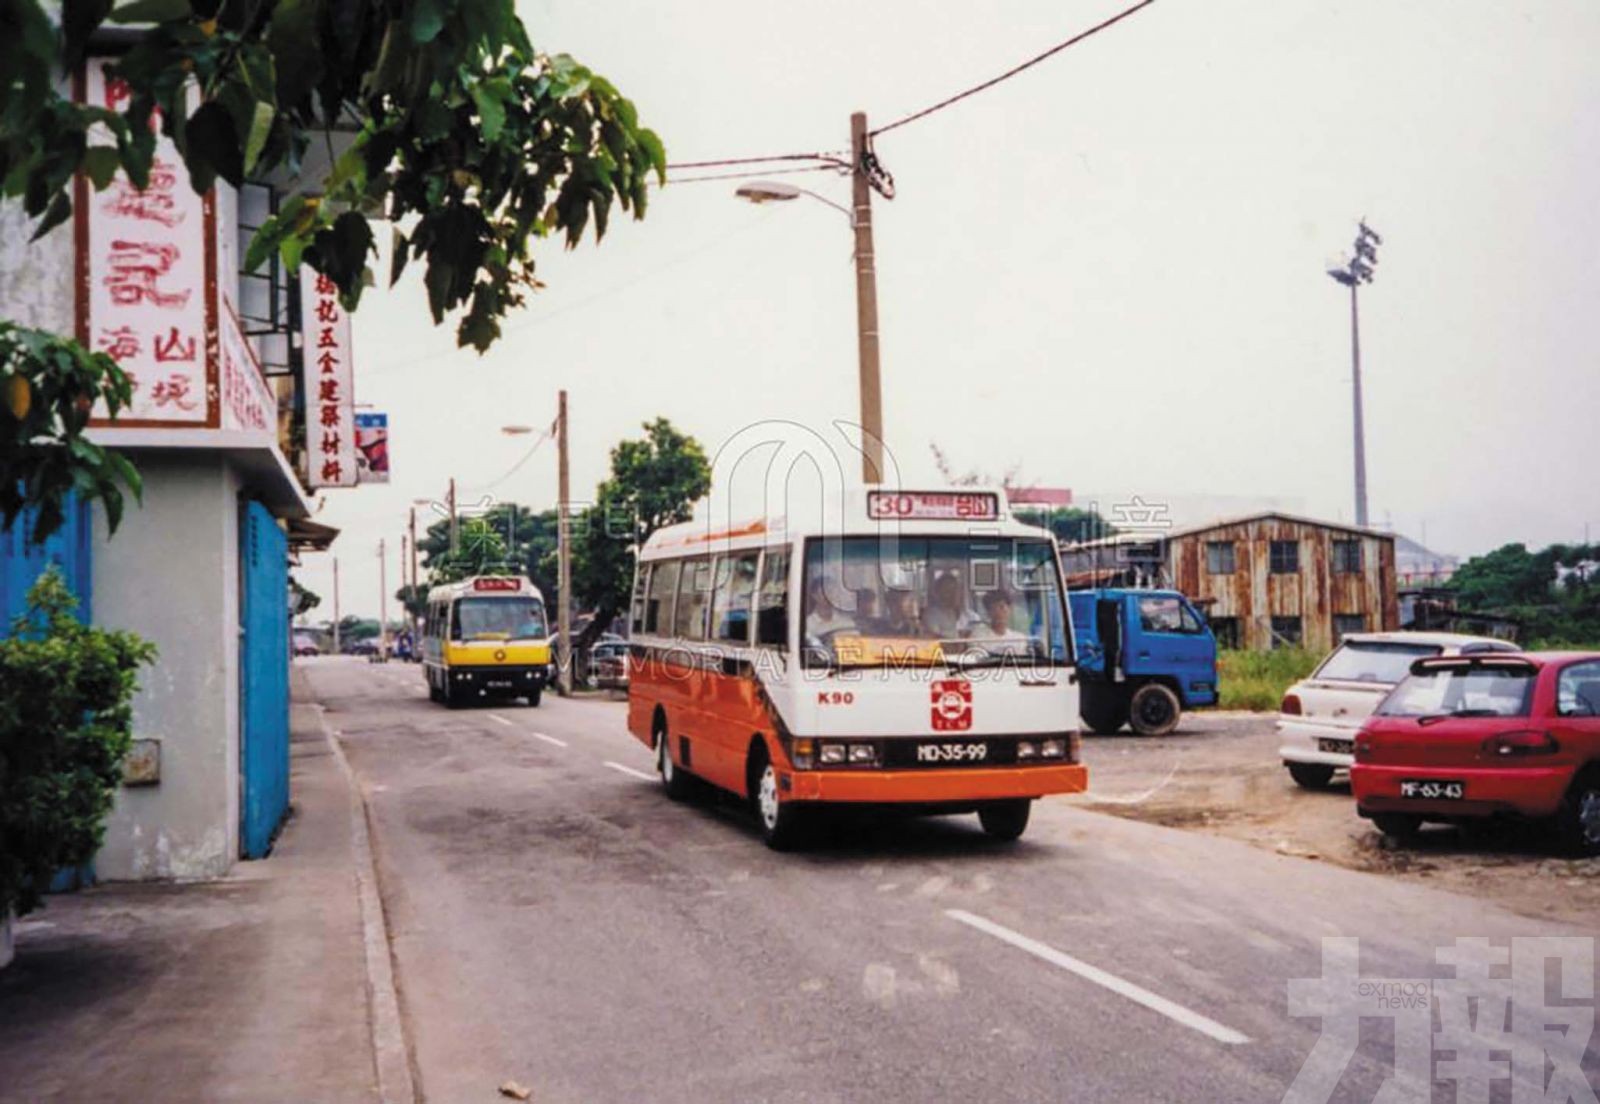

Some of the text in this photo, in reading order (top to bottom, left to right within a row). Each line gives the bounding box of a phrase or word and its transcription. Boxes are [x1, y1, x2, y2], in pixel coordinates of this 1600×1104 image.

[874, 494, 913, 516] 30
[818, 692, 854, 705] K90
[917, 743, 988, 762] MD-35-99
[1400, 781, 1462, 798] MF-63-43
